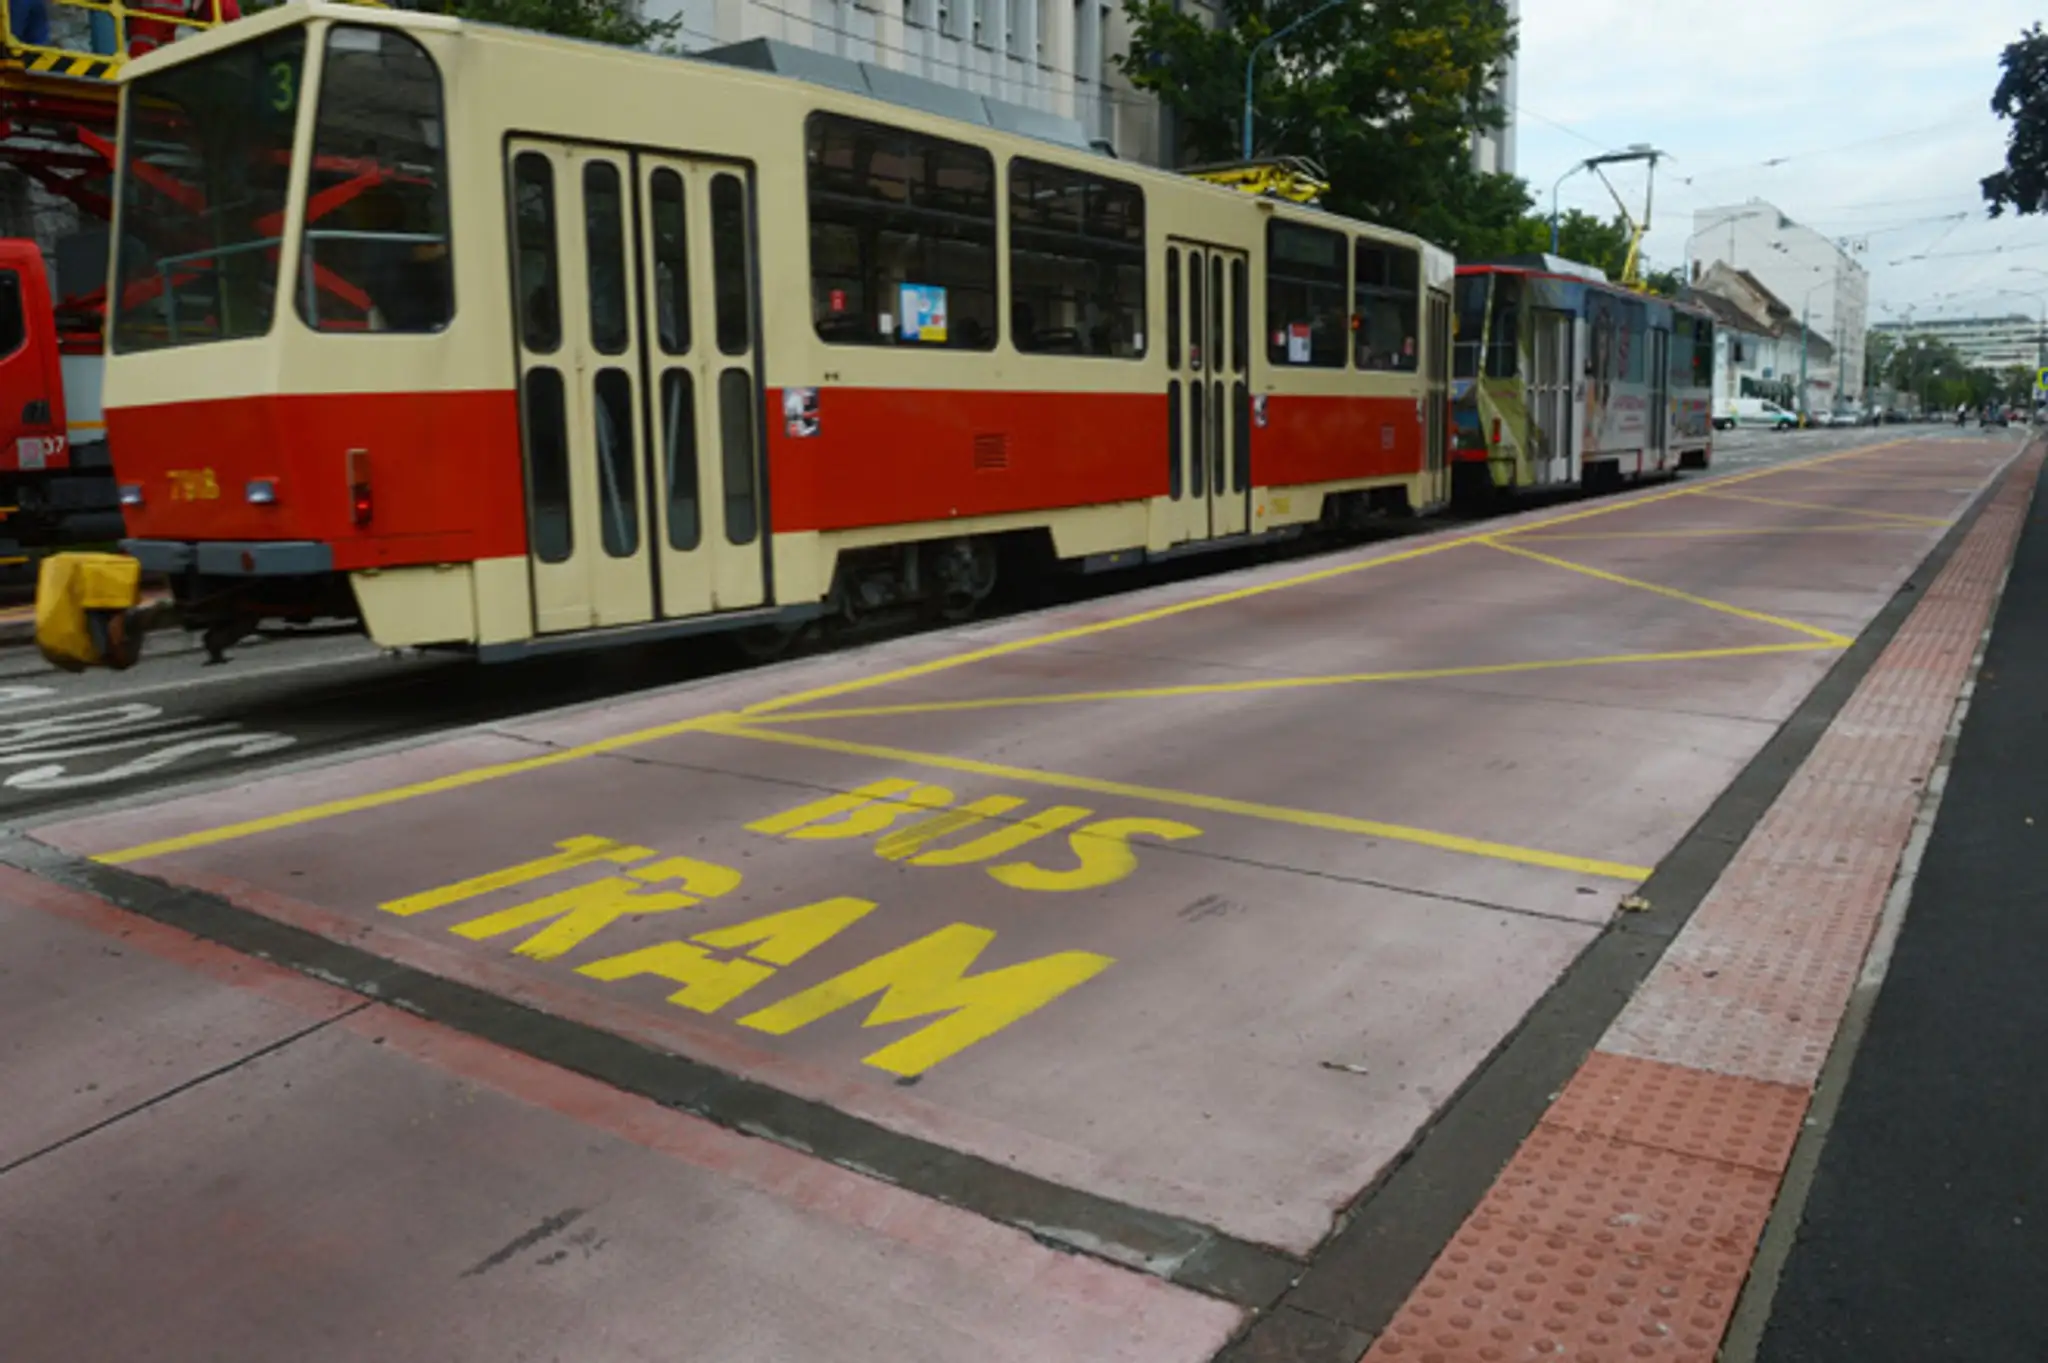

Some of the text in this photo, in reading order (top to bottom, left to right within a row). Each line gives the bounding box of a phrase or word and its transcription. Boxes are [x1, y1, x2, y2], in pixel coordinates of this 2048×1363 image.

[269, 62, 293, 111] 3
[744, 777, 1203, 892] BUS
[377, 834, 1117, 1078] TRAM
